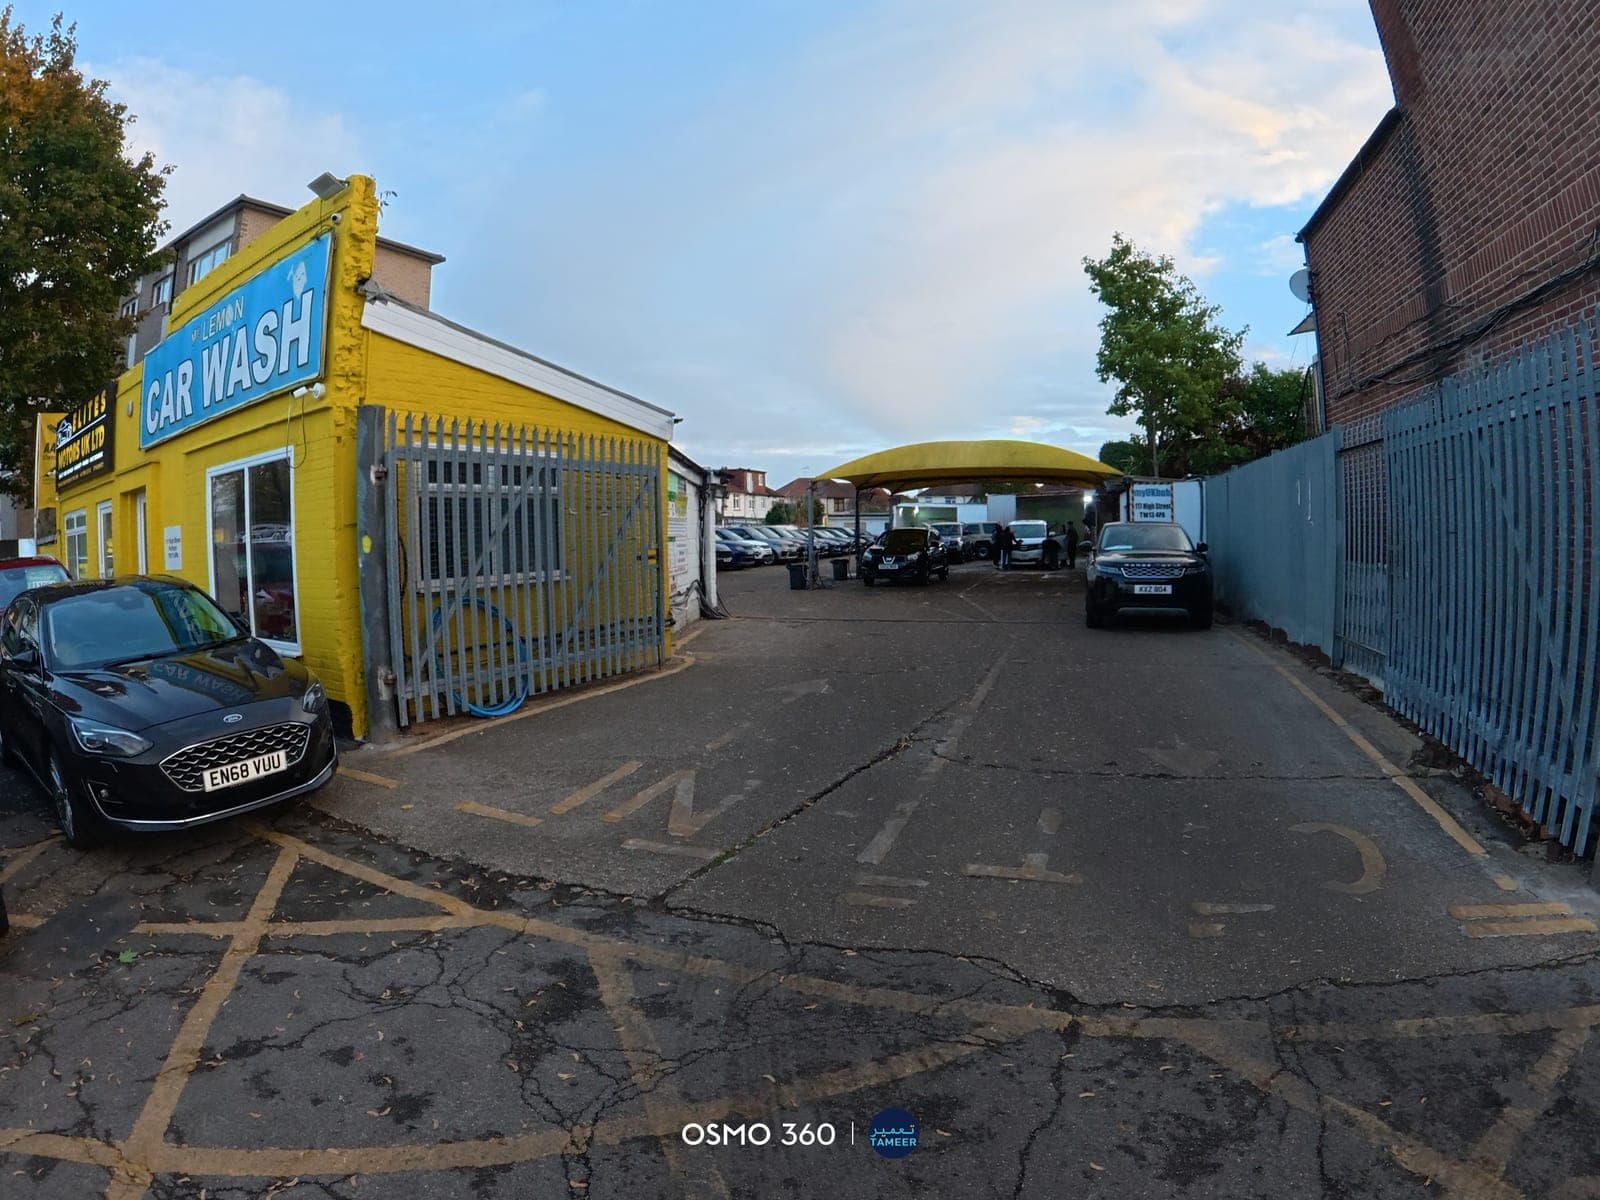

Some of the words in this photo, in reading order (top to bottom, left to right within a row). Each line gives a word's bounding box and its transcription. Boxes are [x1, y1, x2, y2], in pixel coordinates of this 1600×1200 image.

[202, 295, 245, 341] LEMON
[145, 359, 193, 435] CAR
[202, 287, 315, 410] WASH
[73, 388, 107, 433] ELITES
[58, 440, 80, 471] MOTORS
[81, 431, 91, 457] UK
[91, 424, 105, 452] LTD
[210, 763, 249, 787] EN68
[252, 753, 281, 775] VUU
